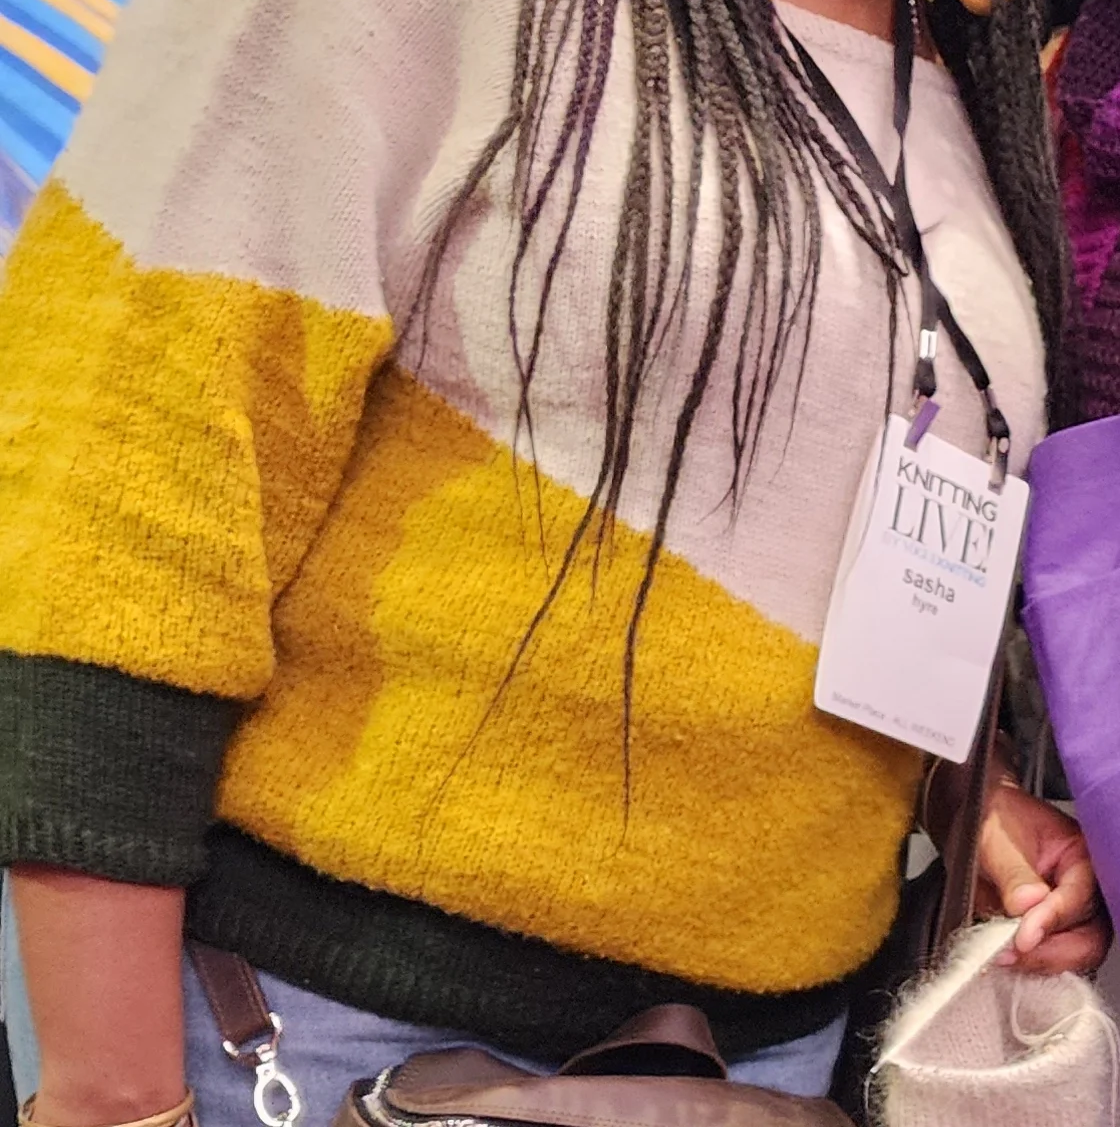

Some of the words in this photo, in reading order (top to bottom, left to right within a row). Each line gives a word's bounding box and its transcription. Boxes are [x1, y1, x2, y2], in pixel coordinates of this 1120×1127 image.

[897, 455, 998, 522] KNITTING
[889, 483, 994, 573] LIVE!
[902, 567, 956, 603] sasha
